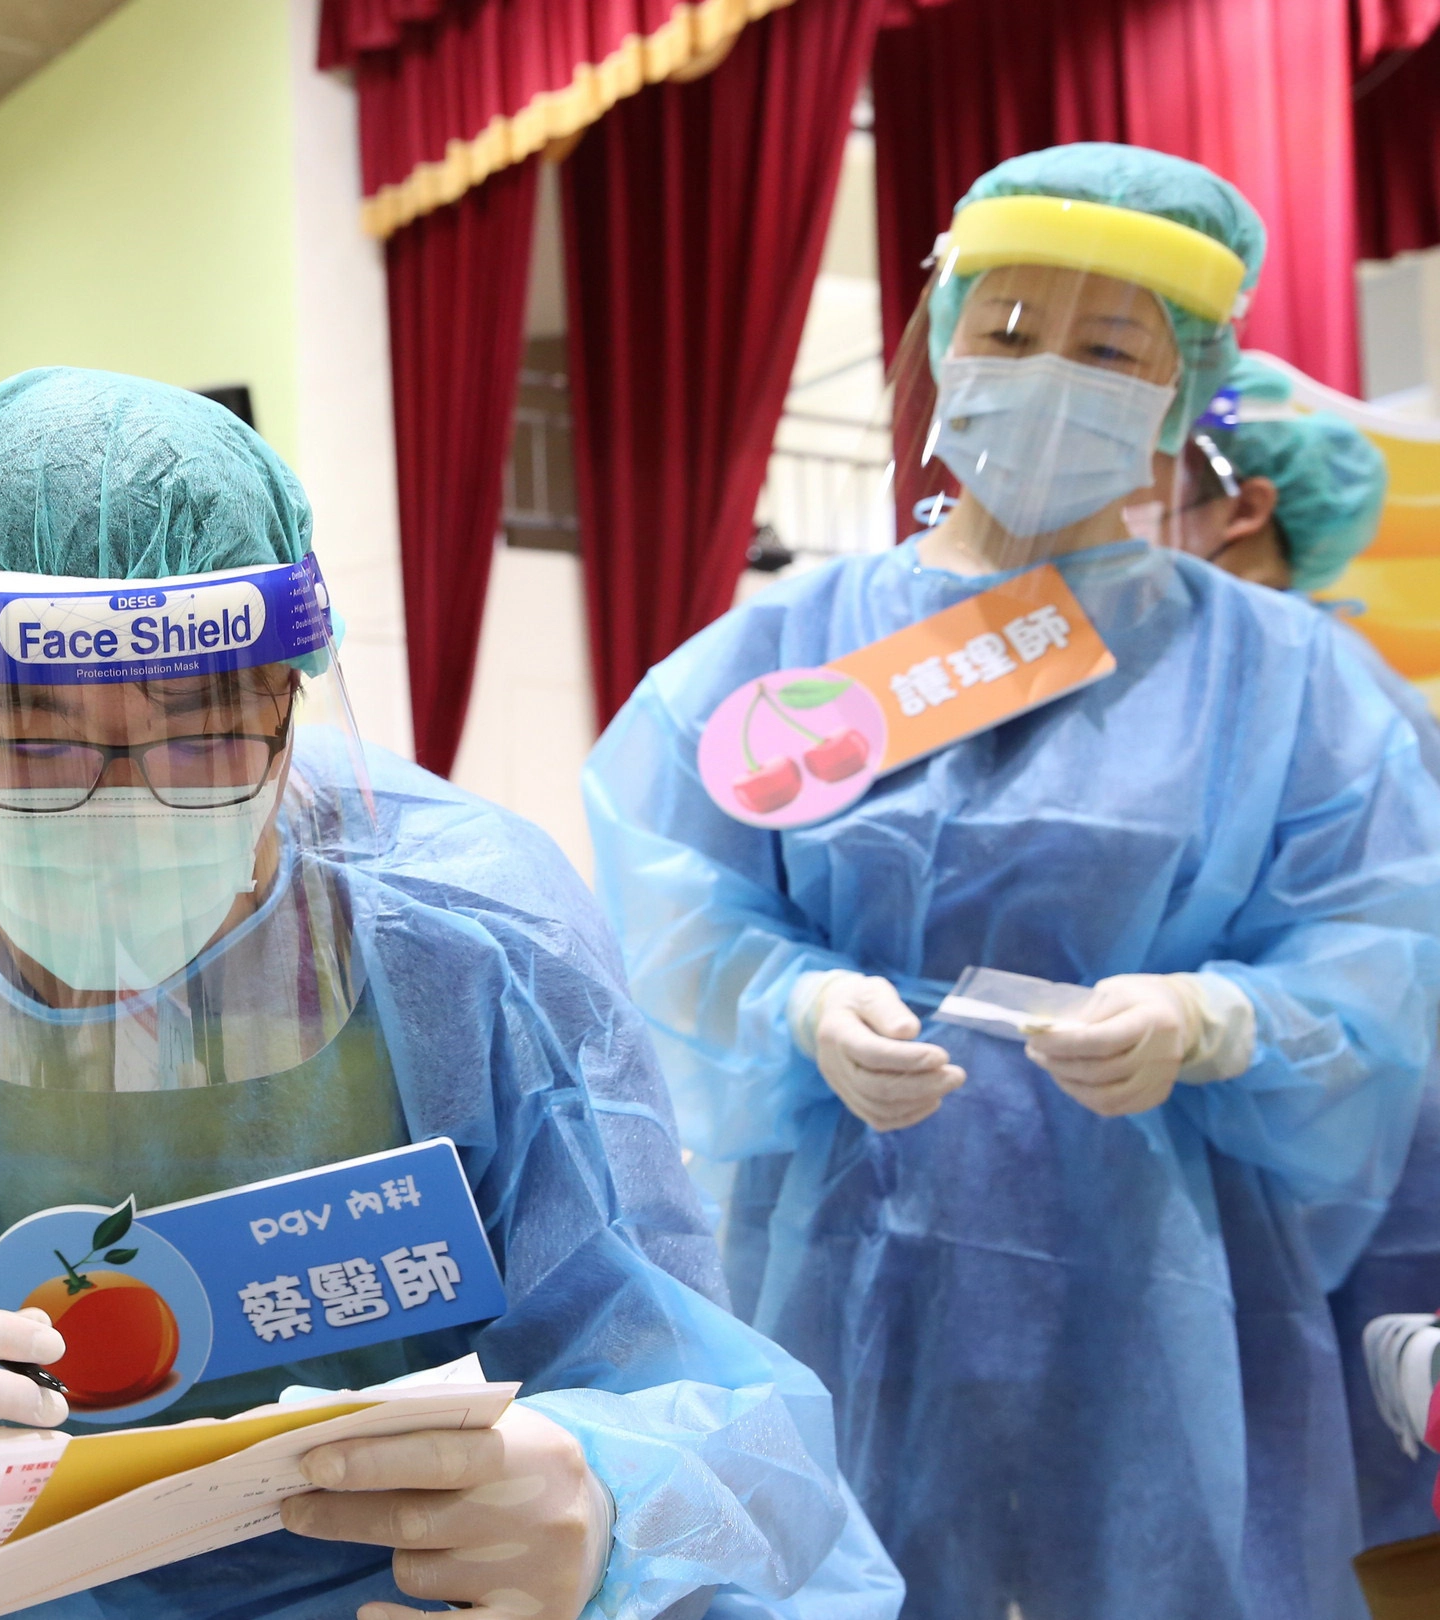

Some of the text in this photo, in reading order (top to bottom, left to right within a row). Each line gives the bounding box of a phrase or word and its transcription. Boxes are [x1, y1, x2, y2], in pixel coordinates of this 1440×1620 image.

[117, 595, 157, 609] DESE
[19, 604, 252, 659] Face Shield
[76, 661, 200, 679] Protection Isolation Mask
[889, 603, 1072, 718] 護理師
[238, 1240, 461, 1343] 蔡醫師
